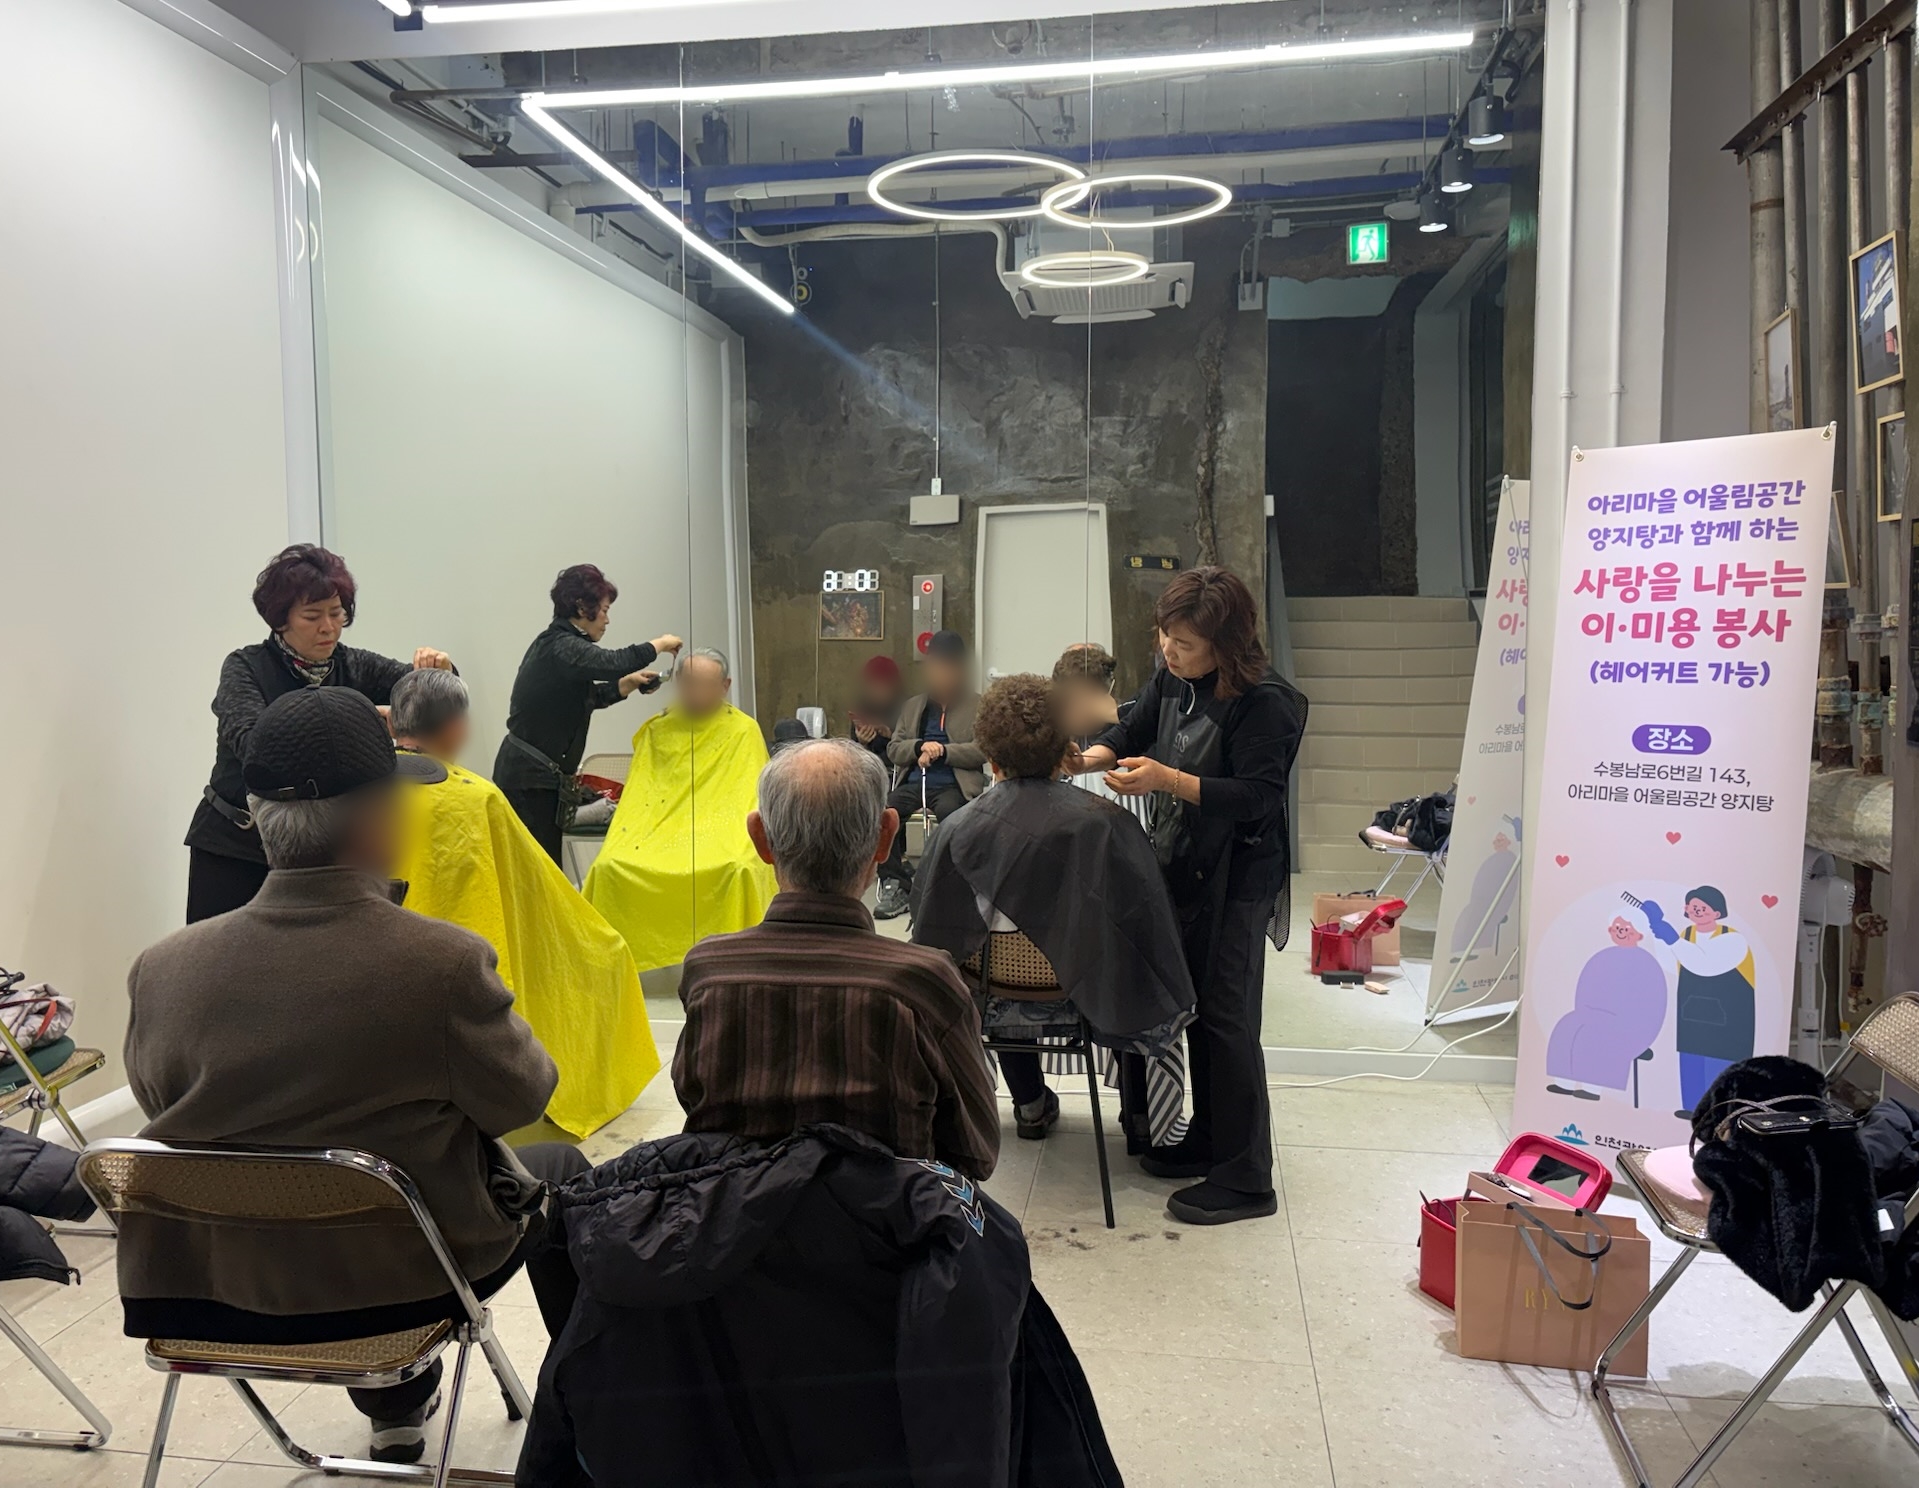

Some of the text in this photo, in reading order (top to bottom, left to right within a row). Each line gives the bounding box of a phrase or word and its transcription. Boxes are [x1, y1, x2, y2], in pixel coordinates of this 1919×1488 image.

[1588, 480, 1806, 515] 아리마을 어울림공간
[1588, 517, 1799, 551] 양지탕과 함께 하는
[1574, 560, 1806, 603] 사랑을 나누는
[1582, 608, 1791, 649] 이·미용 봉사
[1590, 660, 1770, 688] (헤어커트 가능)
[1648, 728, 1693, 751] 장소
[1594, 761, 1750, 787] 수봉남로6번길 143,
[1568, 784, 1774, 812] 아리마을 어울림공간 양지탕
